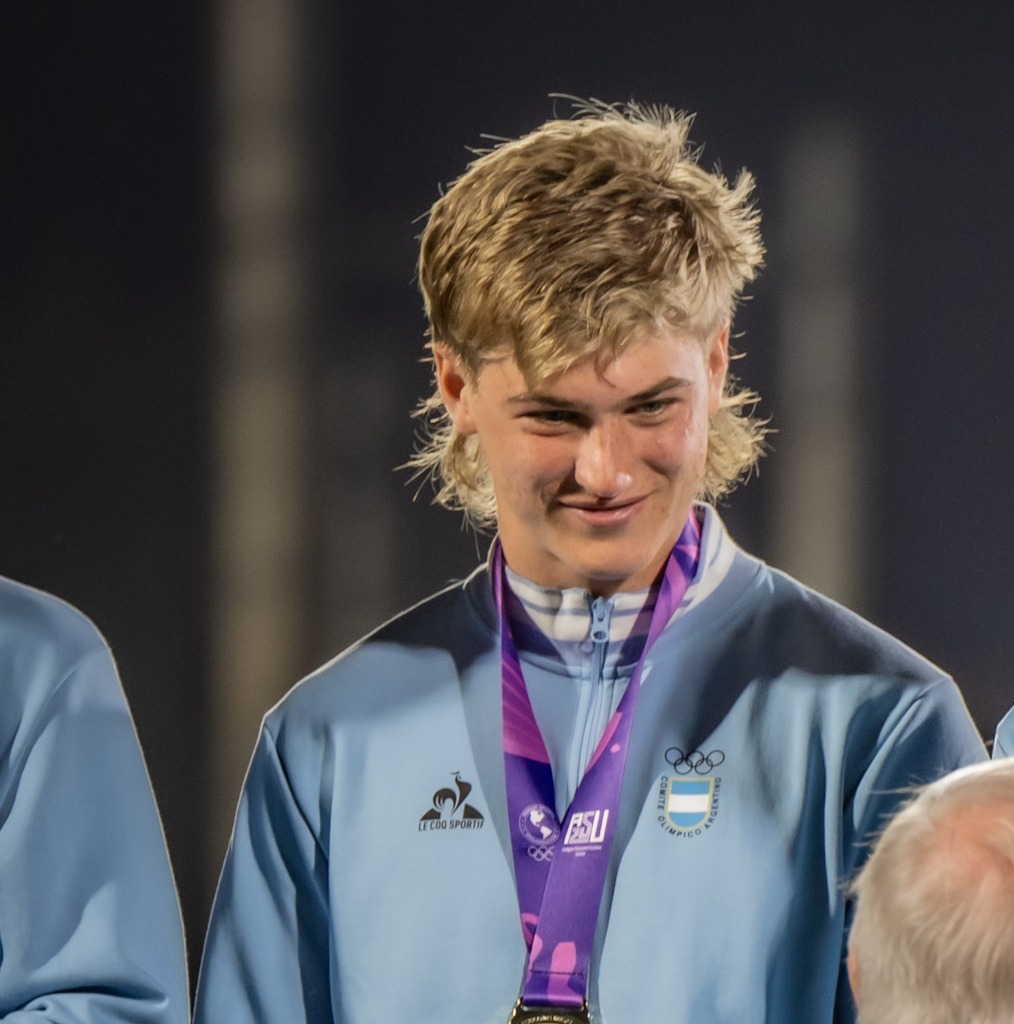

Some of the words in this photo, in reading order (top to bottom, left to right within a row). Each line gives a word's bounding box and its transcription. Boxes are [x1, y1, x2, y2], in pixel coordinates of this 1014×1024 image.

[658, 815, 702, 838] OLIMPICO
[704, 777, 722, 829] ARGENTINO
[418, 821, 427, 832] LE
[430, 820, 447, 830] COQ
